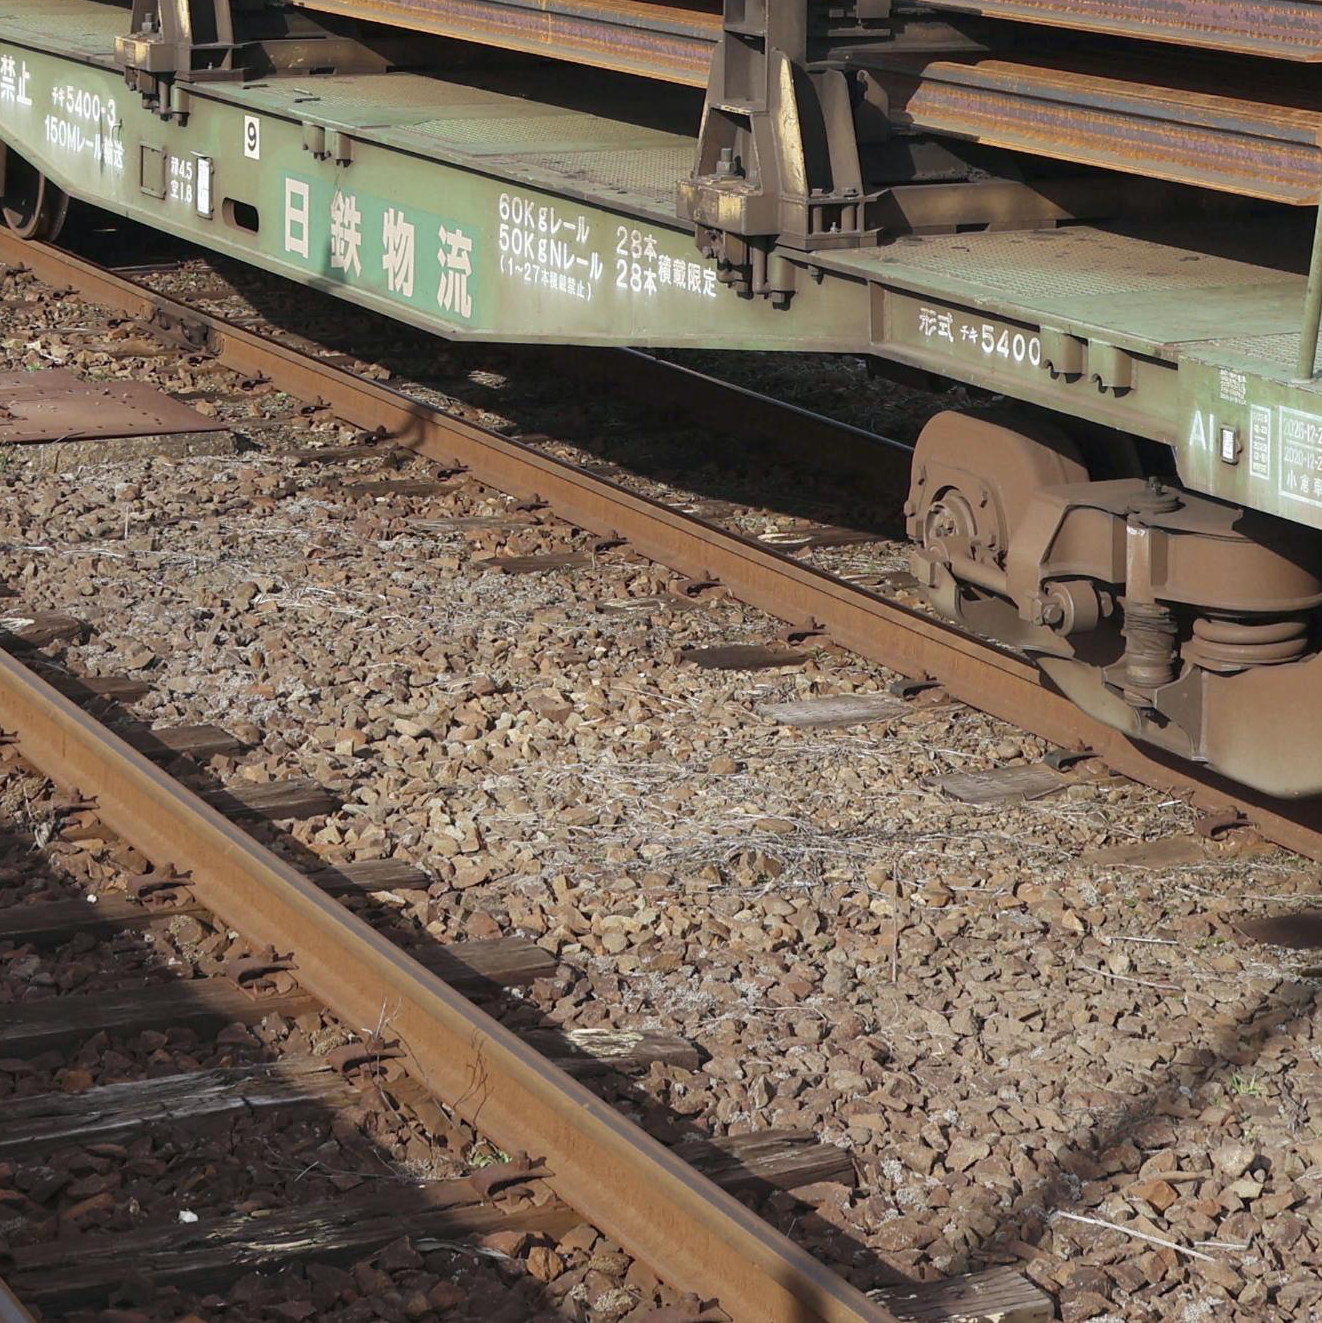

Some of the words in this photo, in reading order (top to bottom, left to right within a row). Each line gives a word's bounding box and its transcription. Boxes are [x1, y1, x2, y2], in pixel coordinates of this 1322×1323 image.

[247, 121, 257, 152] 9
[498, 192, 590, 244] 60Kgレール
[616, 225, 658, 263] 28本
[284, 177, 473, 319] 日鉄物流
[616, 258, 658, 295] 28本
[918, 307, 954, 343] 形式
